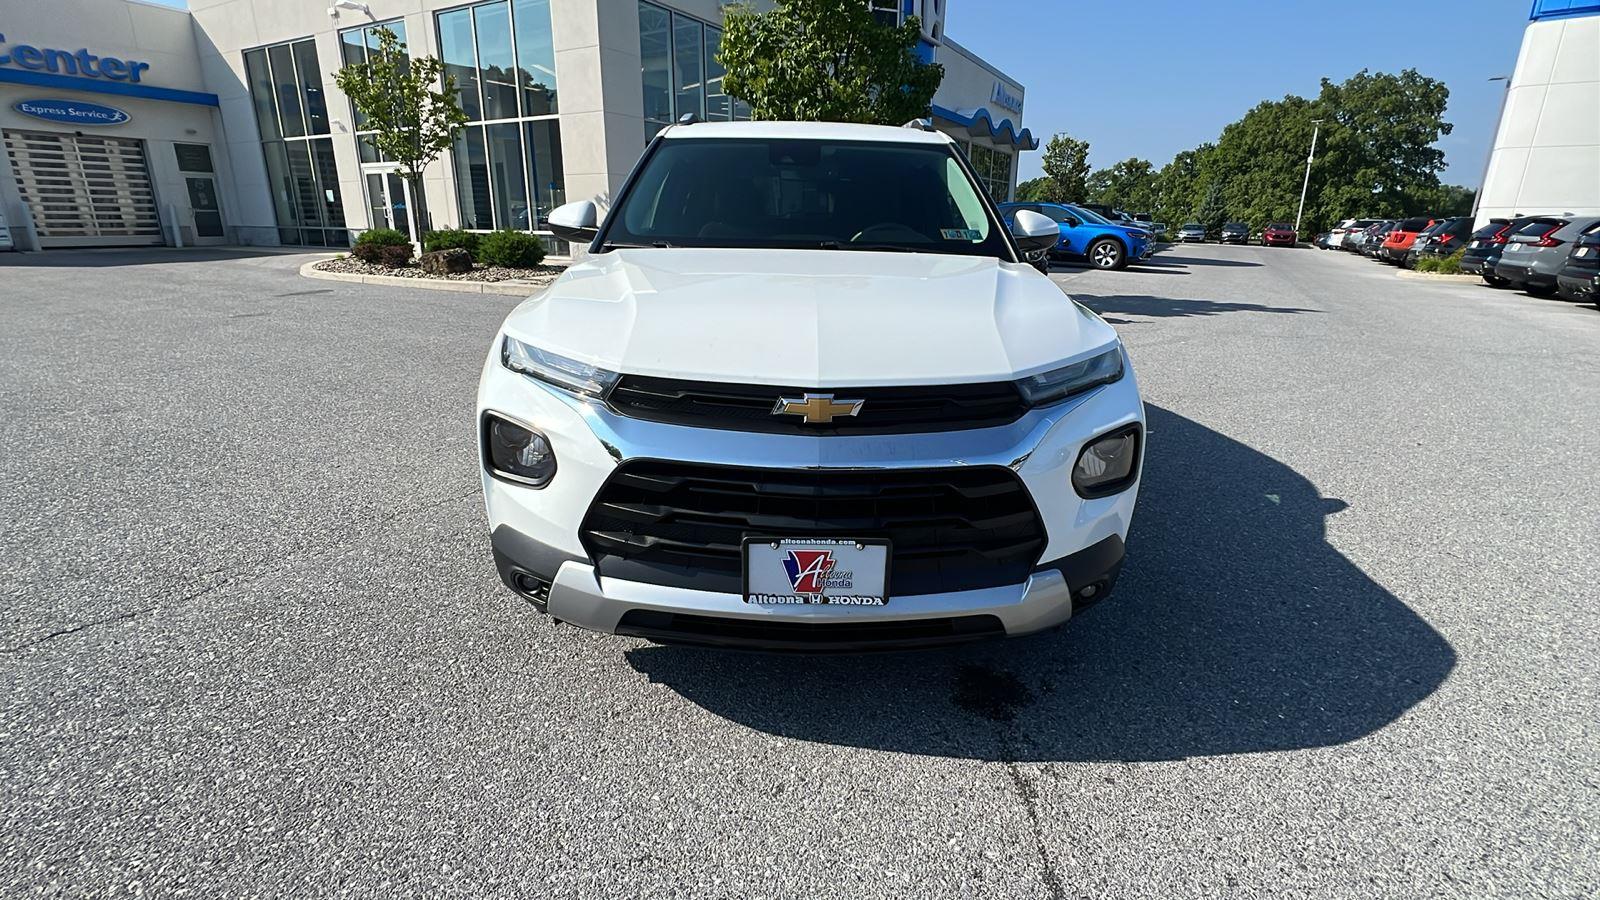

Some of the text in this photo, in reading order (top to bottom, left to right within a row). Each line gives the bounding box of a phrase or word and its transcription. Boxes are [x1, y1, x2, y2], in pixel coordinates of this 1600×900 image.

[21, 103, 108, 119] Express Service
[816, 578, 853, 588] Honda
[748, 594, 804, 605] Altoona
[828, 596, 884, 606] HONDA
